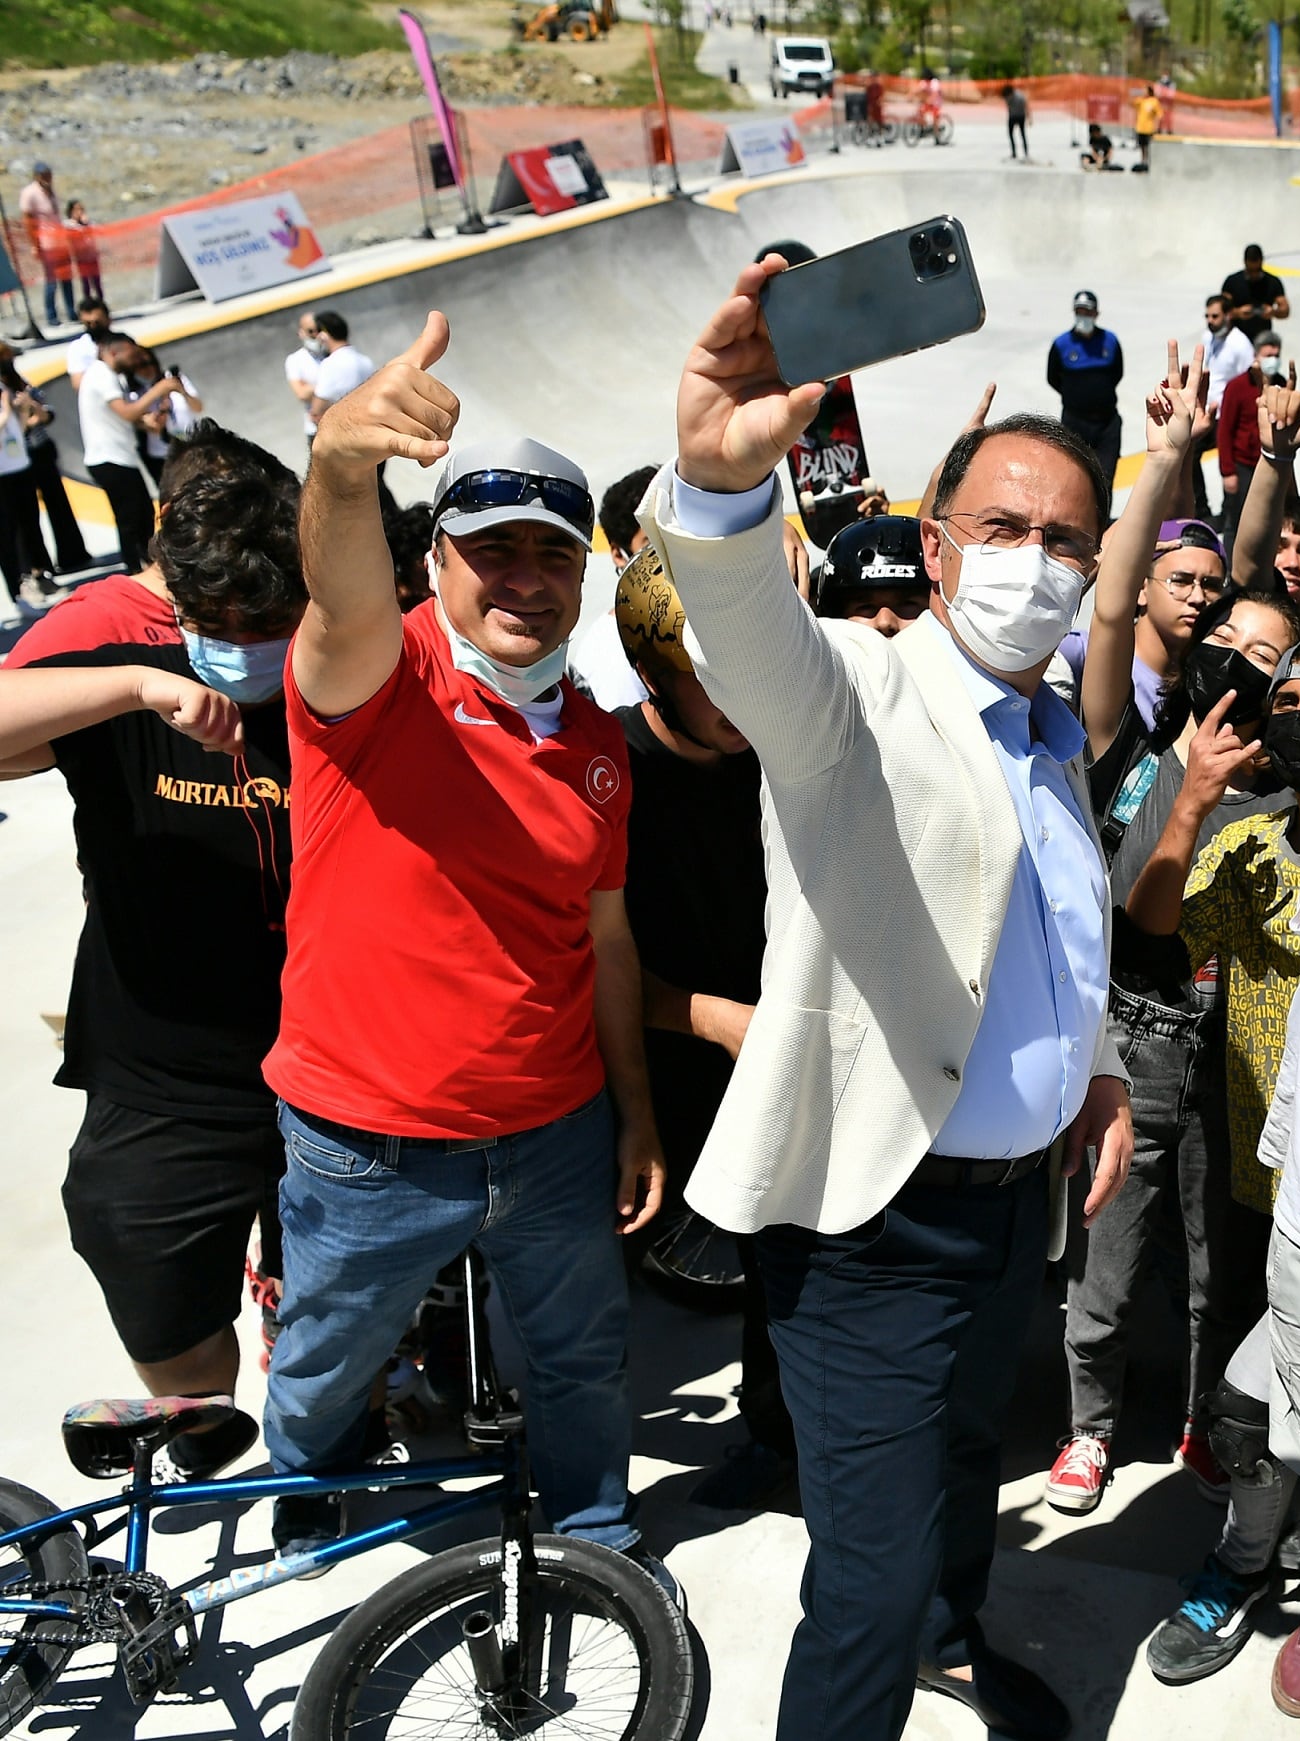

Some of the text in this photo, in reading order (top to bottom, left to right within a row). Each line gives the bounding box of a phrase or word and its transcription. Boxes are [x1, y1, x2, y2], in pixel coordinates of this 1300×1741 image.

[797, 444, 859, 485] BLIND
[860, 564, 918, 580] ROCES
[154, 774, 246, 808] MORTAL
[1252, 1032, 1286, 1052] FORGE
